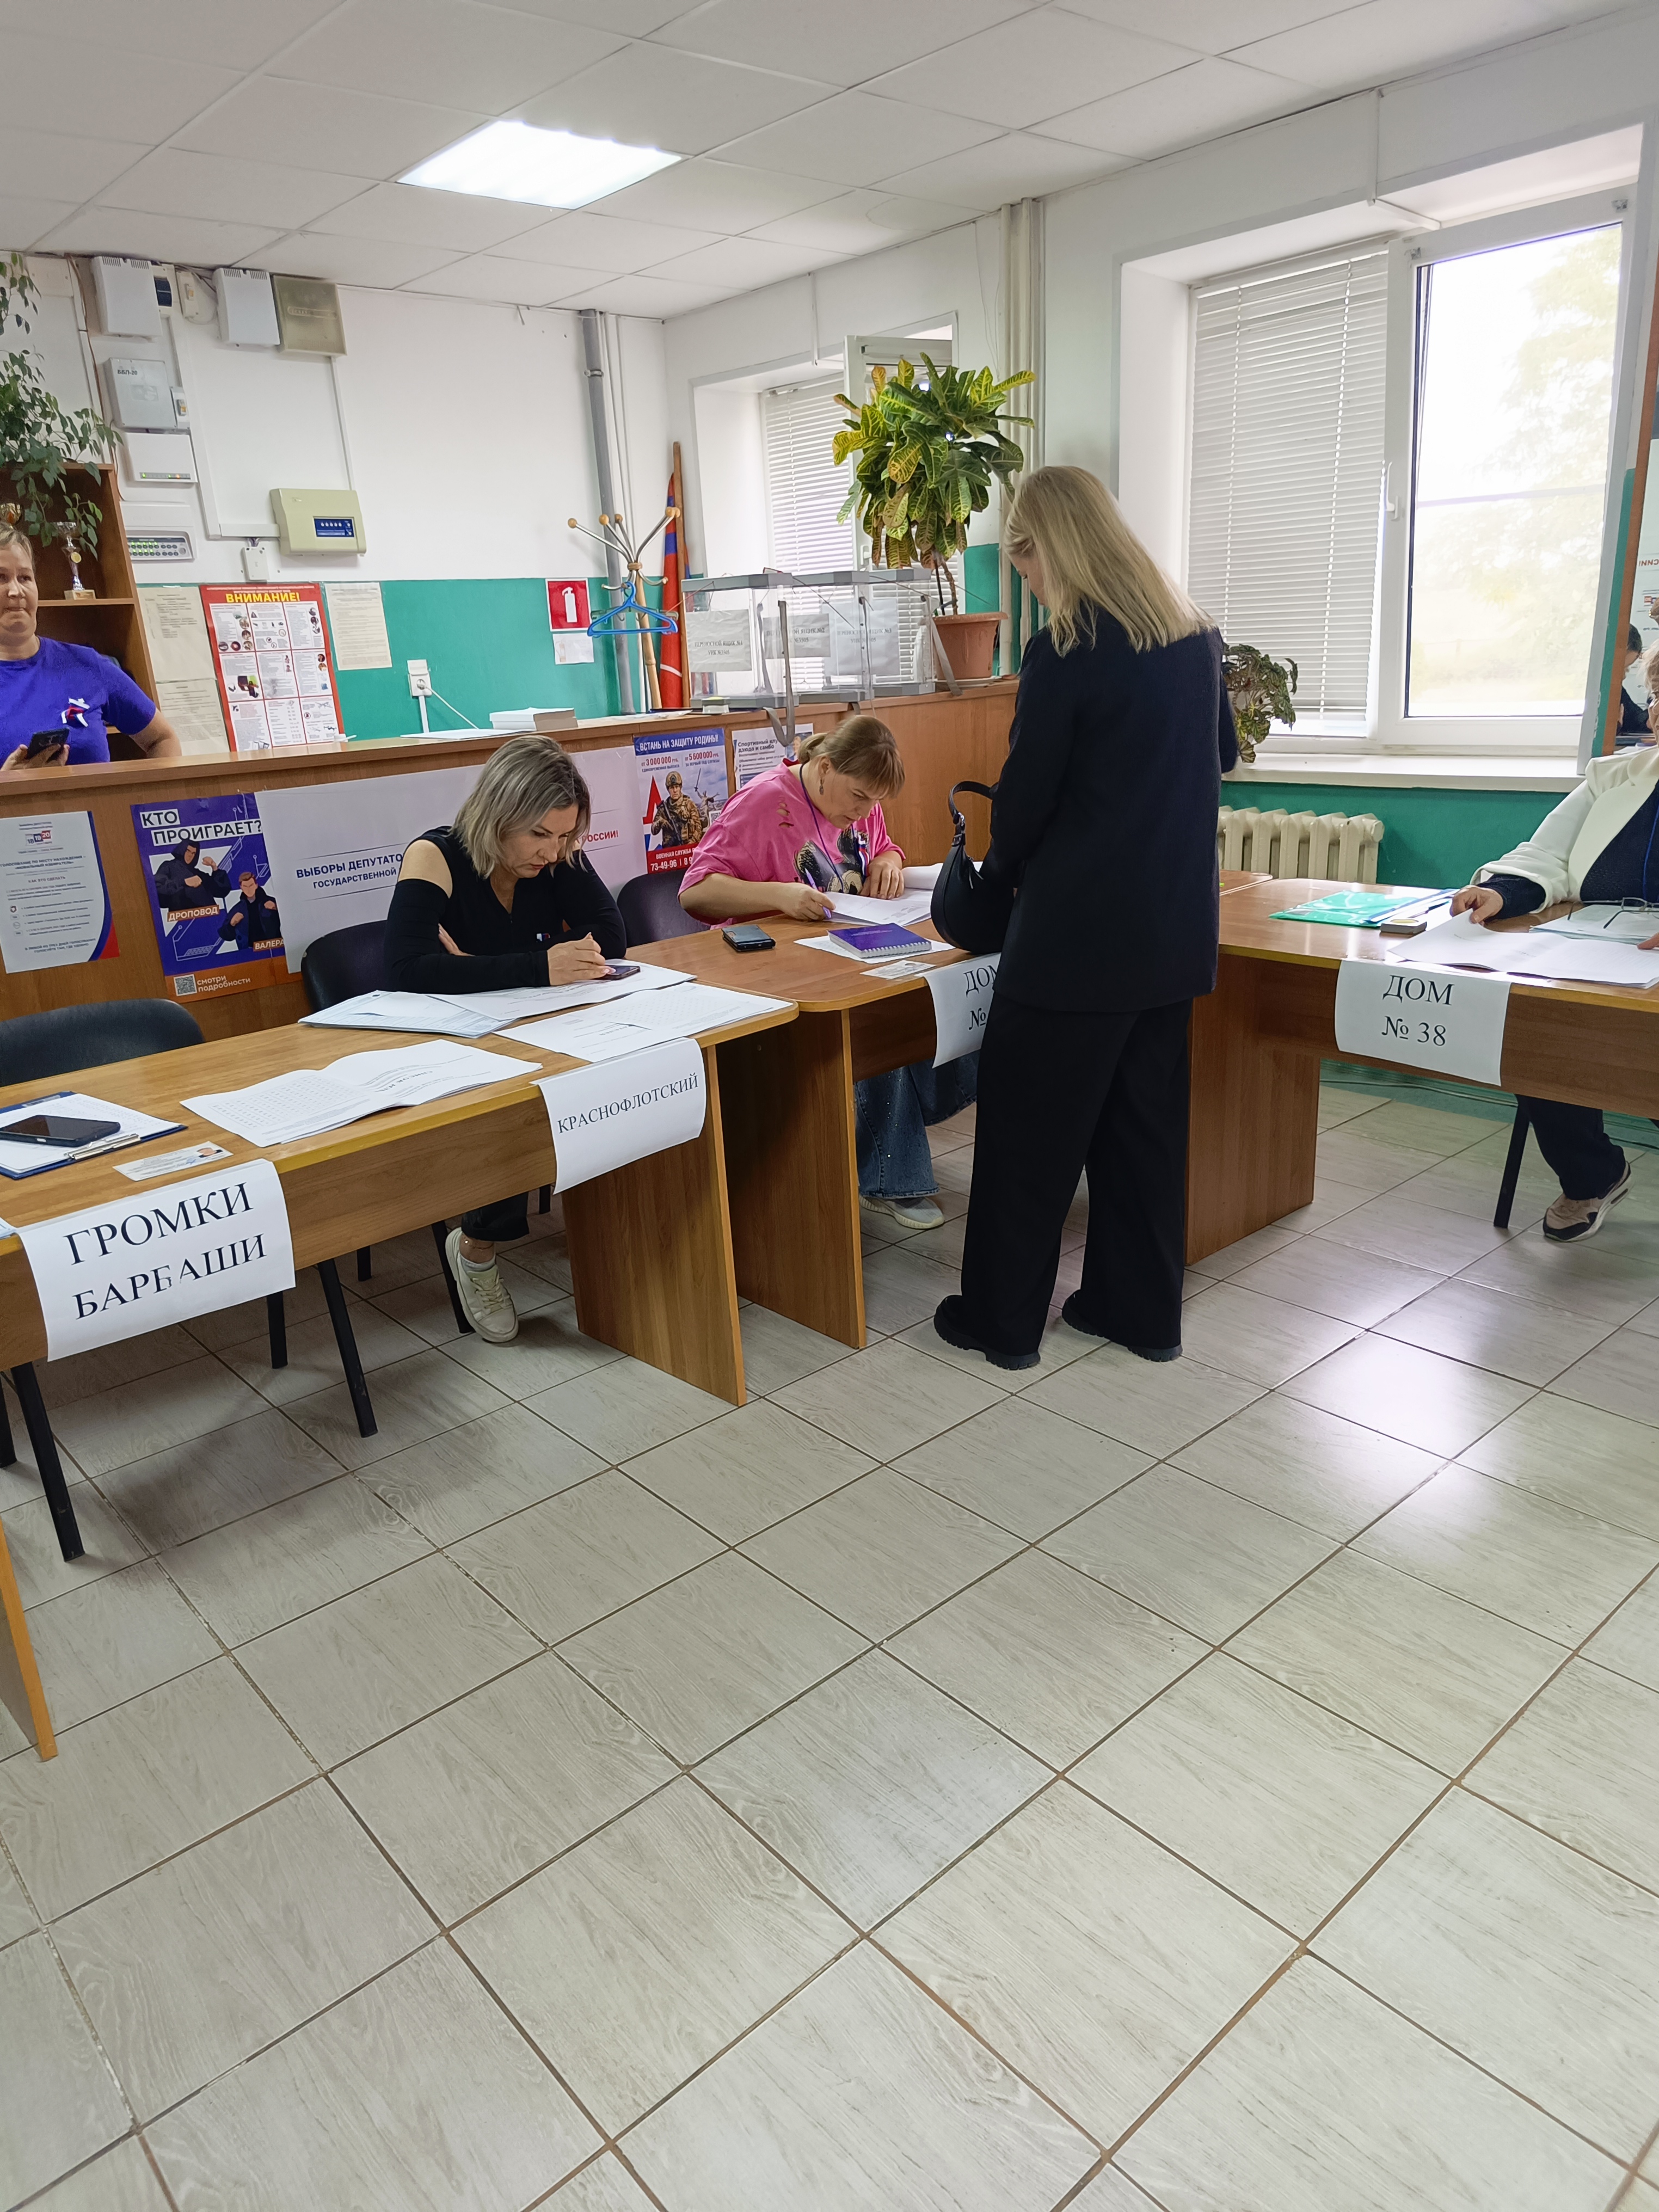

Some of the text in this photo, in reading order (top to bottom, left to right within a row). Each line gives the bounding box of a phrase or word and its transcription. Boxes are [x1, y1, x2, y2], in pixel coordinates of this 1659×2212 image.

[225, 592, 300, 603] ВНИМАНИЕ!
[640, 734, 718, 751] ВСТАНЬ НА ЗАЩИТУ РОДИНЫ!
[738, 739, 769, 747] Спортивный
[142, 811, 177, 826] КТО
[153, 820, 261, 844] ПРОИГРАЕТ?
[656, 851, 674, 859] ВОЕННАЯ
[675, 848, 691, 856] СЛУЖБА
[297, 853, 403, 878] ВЫБОРЫ ДЕПУТАТО
[650, 859, 677, 871] 73-49-96
[313, 867, 397, 889] ГОСУДАРСТВЕННОЙ
[168, 907, 218, 921] ДРОПОВОД
[255, 939, 284, 950] ВАЛЕРА
[197, 975, 226, 986] смотри
[198, 978, 251, 992] подробности
[1382, 975, 1454, 1006] ДОМ
[969, 1007, 986, 1030] №
[1381, 1016, 1446, 1046] № 38
[557, 1072, 699, 1134] КРАСНОФЛОТСКИЙ
[63, 1182, 254, 1265] ГРОМКИ
[72, 1233, 267, 1320] БАРБАШИ
